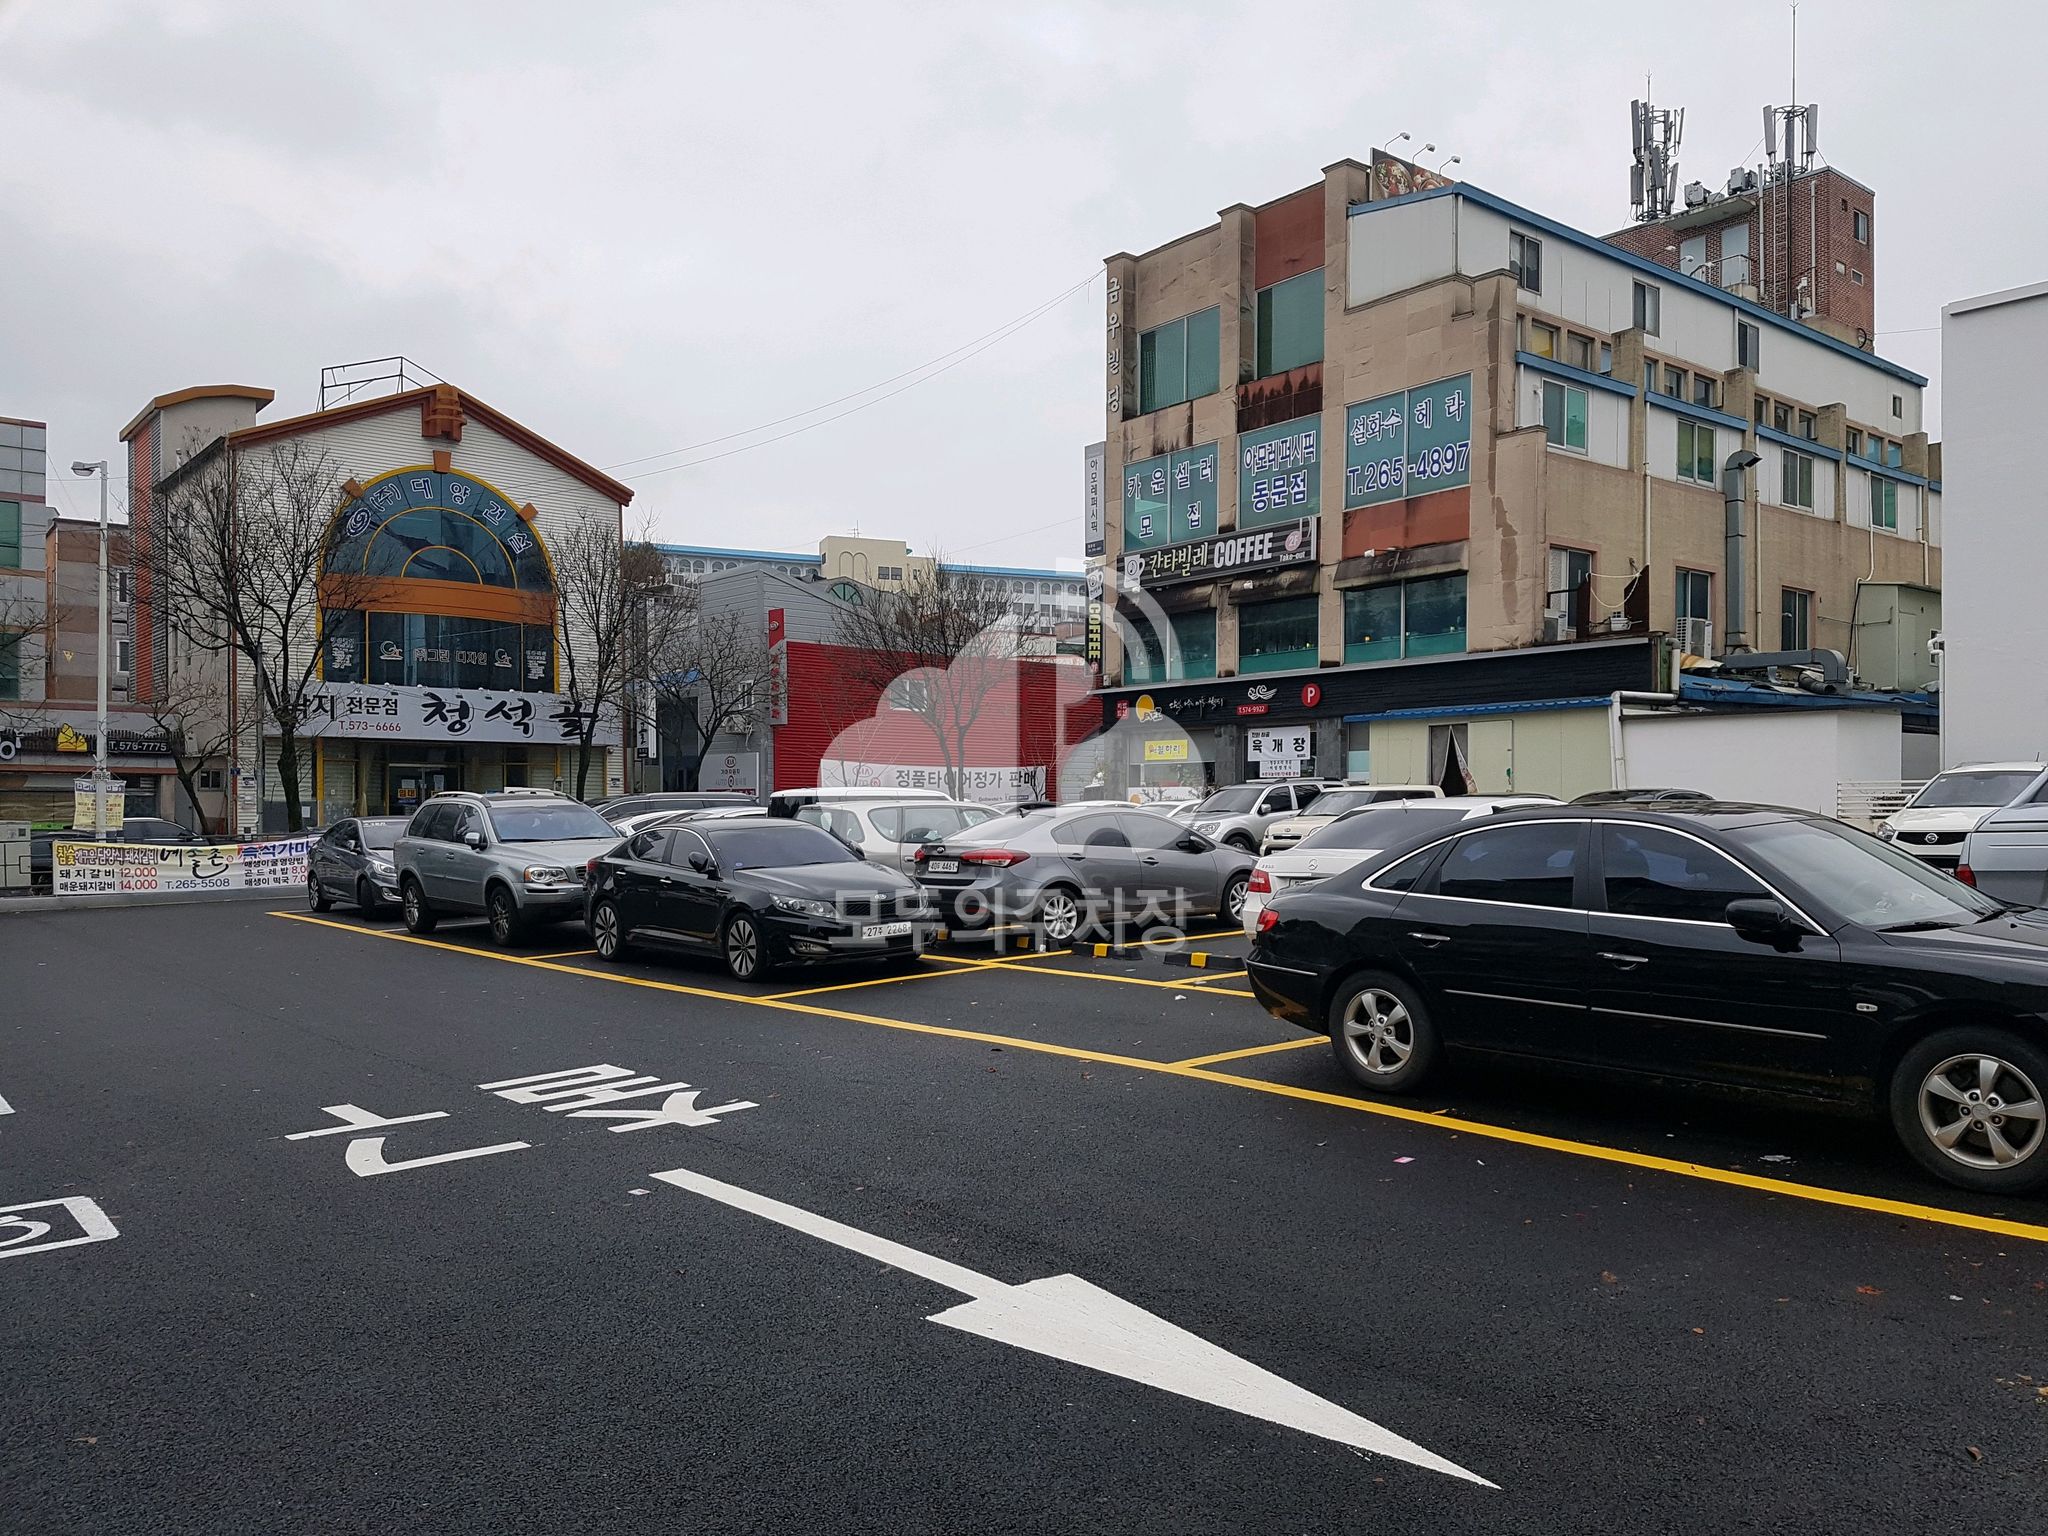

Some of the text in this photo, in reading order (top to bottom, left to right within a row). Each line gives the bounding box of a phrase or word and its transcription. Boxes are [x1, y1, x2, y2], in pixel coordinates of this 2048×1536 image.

[1350, 390, 1466, 445] 설화수 헤라
[1243, 430, 1316, 476] 아모레퍼시픽
[1127, 454, 1215, 500] 카운셀러
[1347, 440, 1471, 497] T.265-4897
[1090, 459, 1098, 533] 아모레퍼시픽
[1252, 470, 1308, 513] 동문점
[1138, 500, 1201, 539] 모집
[1149, 542, 1209, 578] 칸타빌레
[1213, 532, 1274, 568] COFFEE
[1088, 603, 1101, 659] COFFEE
[455, 650, 488, 666] 디자인
[346, 696, 399, 716] 전문점
[339, 720, 401, 732] T.573-6666
[1252, 737, 1306, 754] 육개장
[1009, 769, 1038, 788] 판매
[97, 846, 124, 866] 담양식
[124, 846, 159, 866] 돼지갈비
[59, 867, 158, 880] 돼지갈비 12,000
[244, 877, 270, 886] 매생이
[292, 874, 308, 884] 7,0
[291, 865, 308, 875] 8,0
[59, 879, 158, 892] 매운돼지갈비 14,000
[165, 878, 230, 890] T.265-5508
[887, 923, 908, 935] 2268
